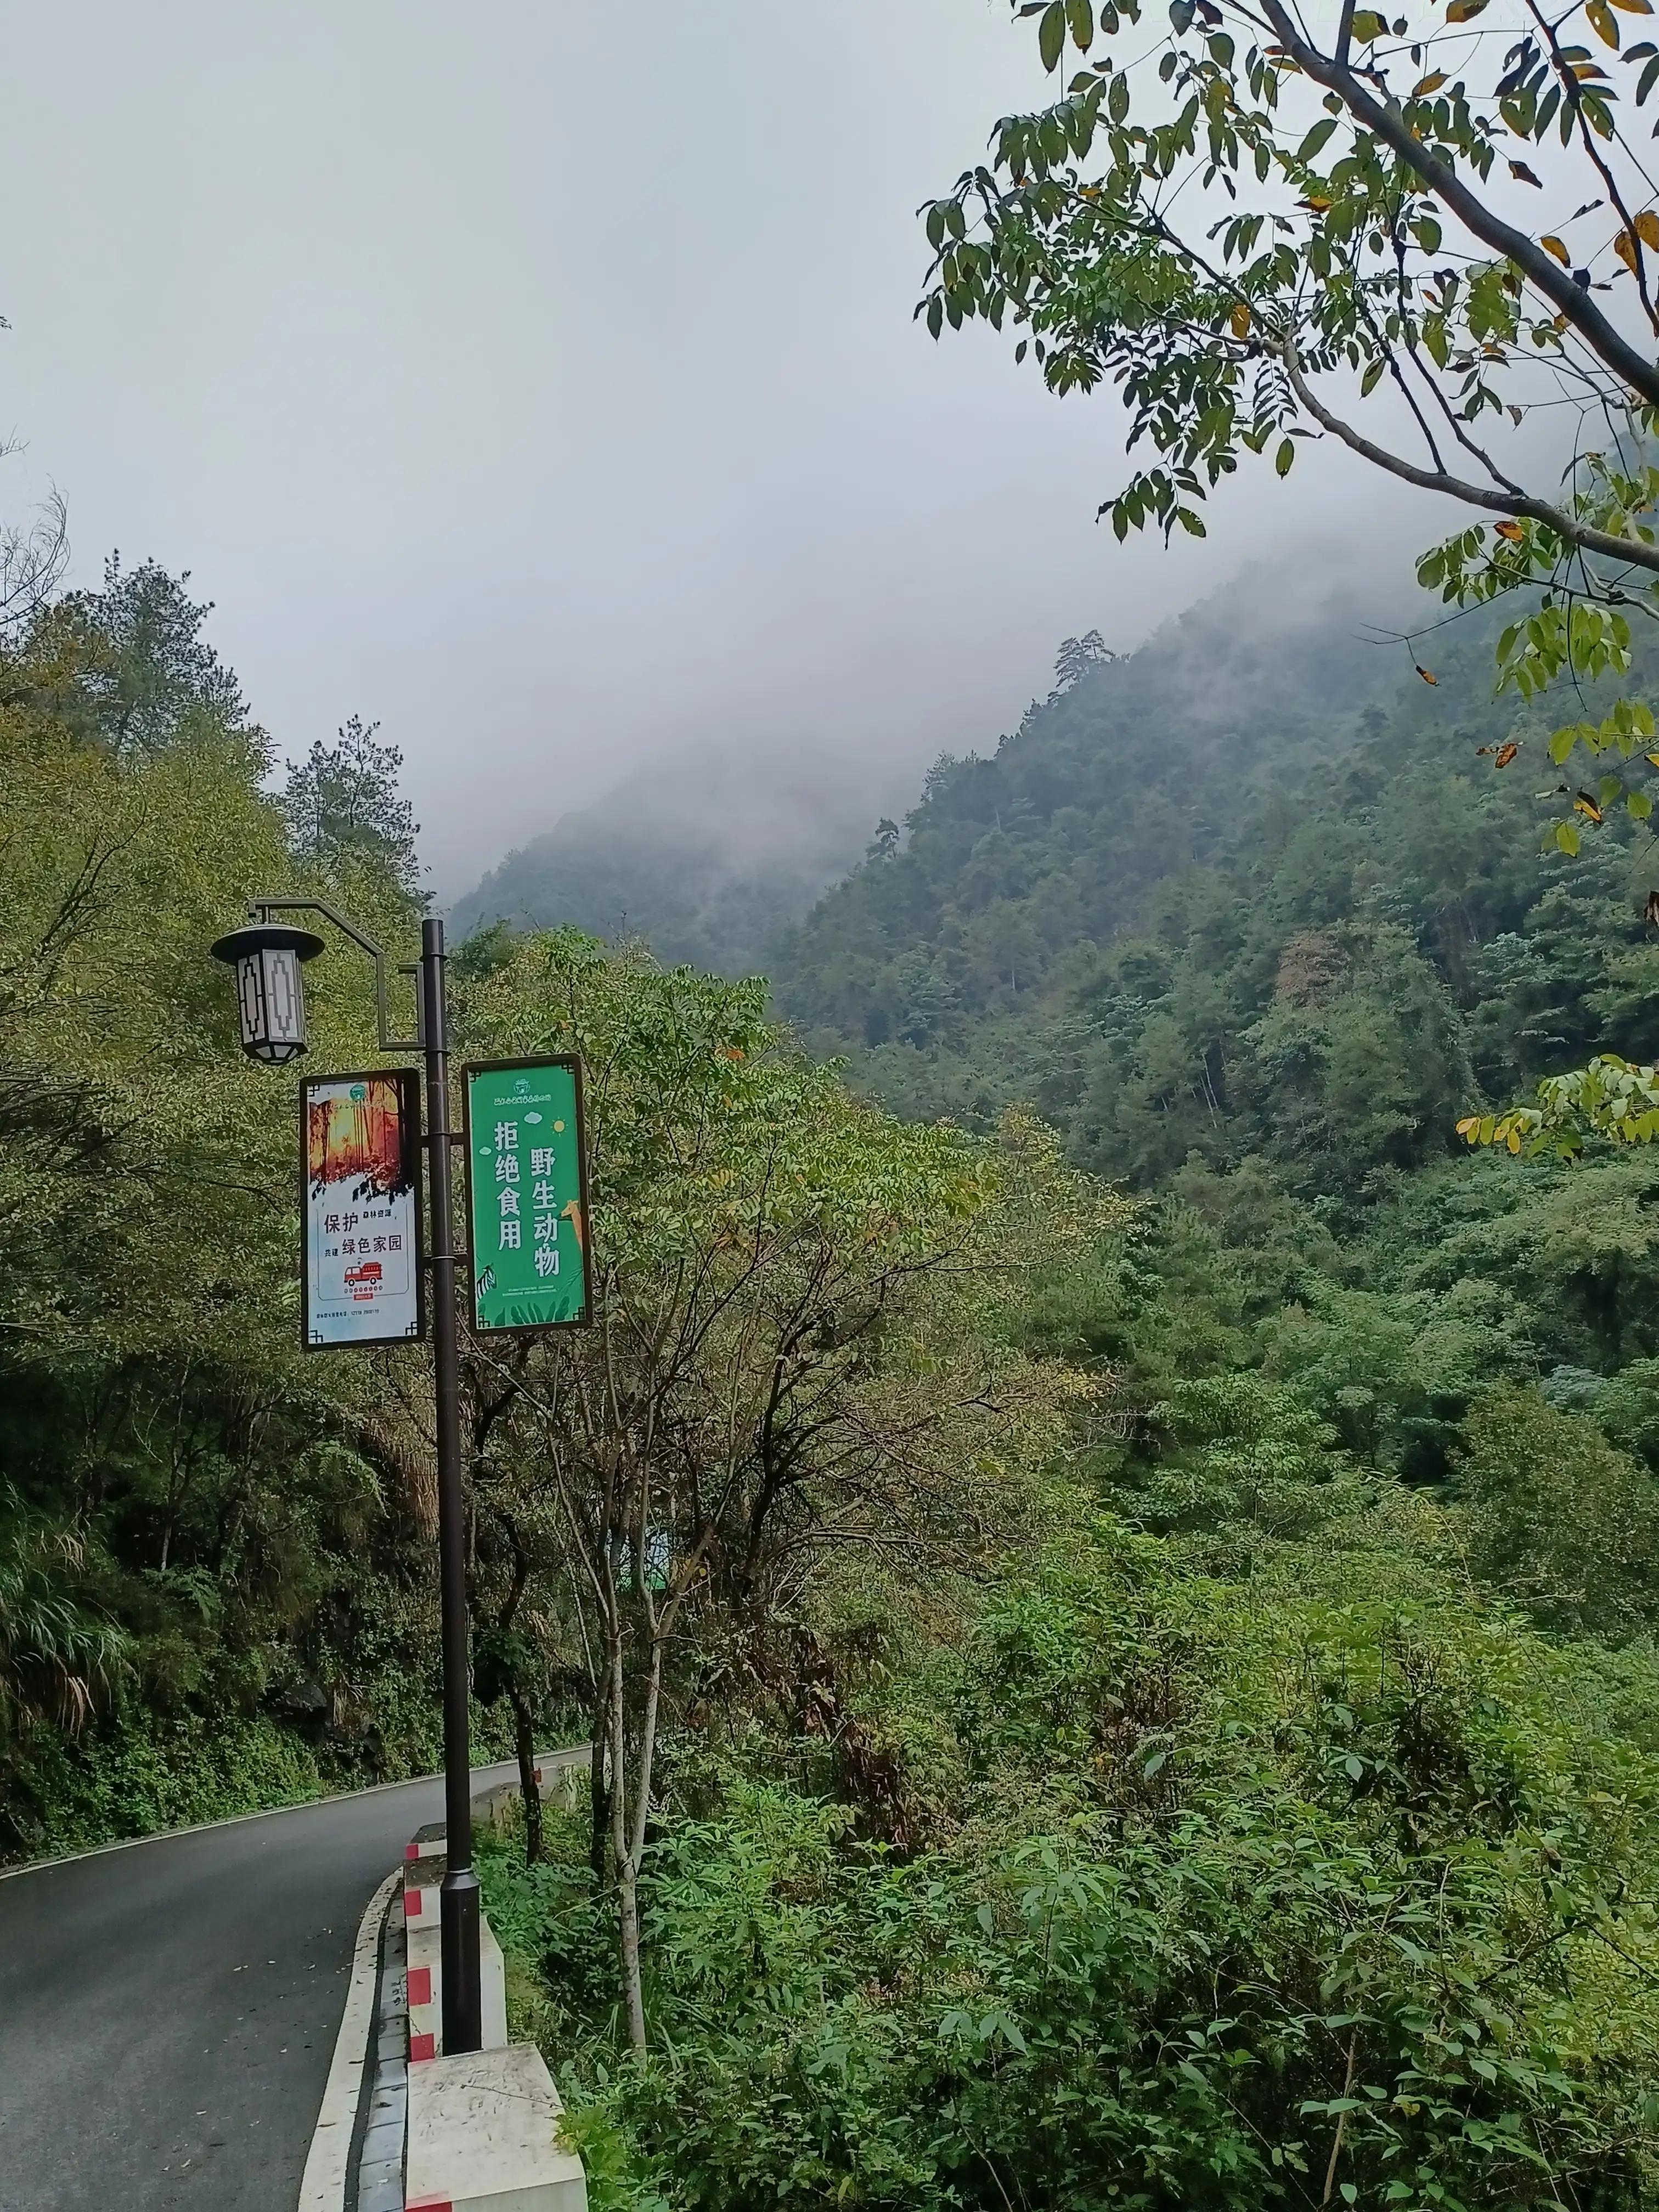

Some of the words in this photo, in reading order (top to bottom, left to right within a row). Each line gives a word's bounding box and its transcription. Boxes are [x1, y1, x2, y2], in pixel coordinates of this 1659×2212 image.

[324, 1211, 359, 1234] 保护
[494, 1121, 521, 1251] 拒绝食用
[531, 1147, 560, 1278] 野生动物
[342, 1234, 402, 1255] 绿色家园
